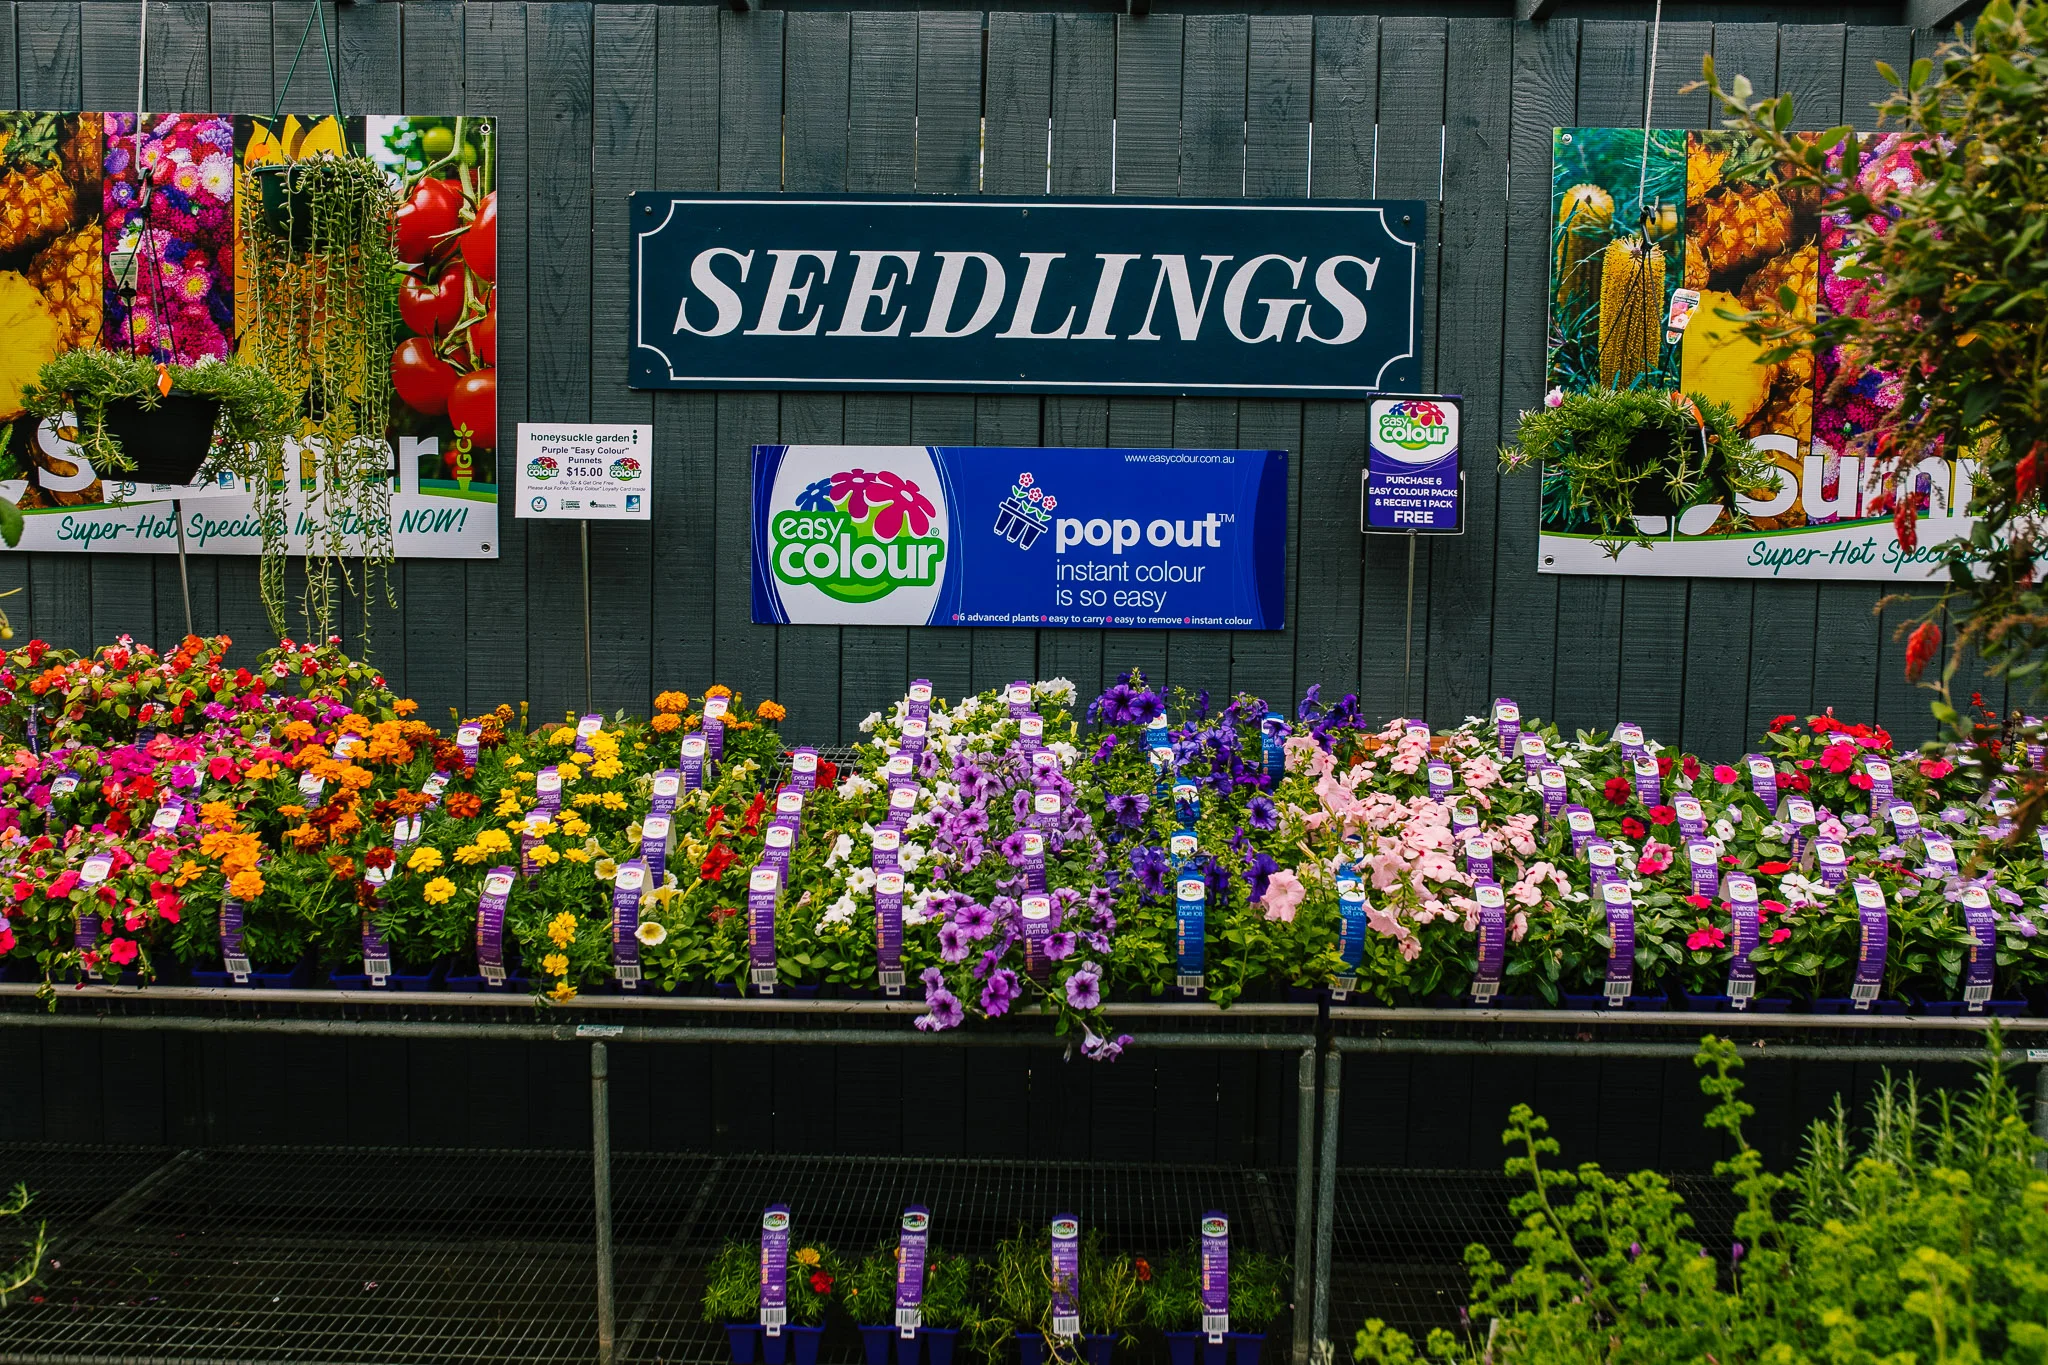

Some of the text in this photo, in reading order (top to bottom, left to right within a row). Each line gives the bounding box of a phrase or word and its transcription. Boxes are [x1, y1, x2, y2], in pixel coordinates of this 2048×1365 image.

[672, 246, 1381, 345] SEEDLINGS
[1381, 416, 1409, 428] easy
[530, 433, 630, 444] honeysuckle garden
[1381, 424, 1447, 443] colour
[456, 437, 472, 475] IGC
[541, 446, 630, 456] Purple "Easy Colour"
[1124, 454, 1235, 465] www.easycolour.com.au
[528, 467, 559, 477] colour
[566, 467, 603, 477] $15.00
[610, 468, 641, 478] colour
[1386, 476, 1434, 485] PURCHASE
[1393, 488, 1430, 496] COLOUR
[1383, 499, 1422, 507] RECEIVE
[1428, 500, 1453, 508] PACK
[1394, 511, 1434, 524] FREE
[57, 515, 179, 549] Super-Hot
[398, 508, 468, 533] NOW!
[779, 518, 844, 544] easy
[1056, 518, 1141, 554] pop
[1146, 513, 1221, 548] out
[779, 533, 938, 579] colour
[1747, 537, 1877, 576] Super-Hot
[1056, 559, 1206, 583] instant colour
[1056, 584, 1168, 613] is so easy
[960, 613, 1253, 626] 6 advanced plants easy to carry easy to remove instant colour
[643, 841, 664, 849] petunia
[644, 846, 662, 854] yellow
[1025, 928, 1040, 936] plum
